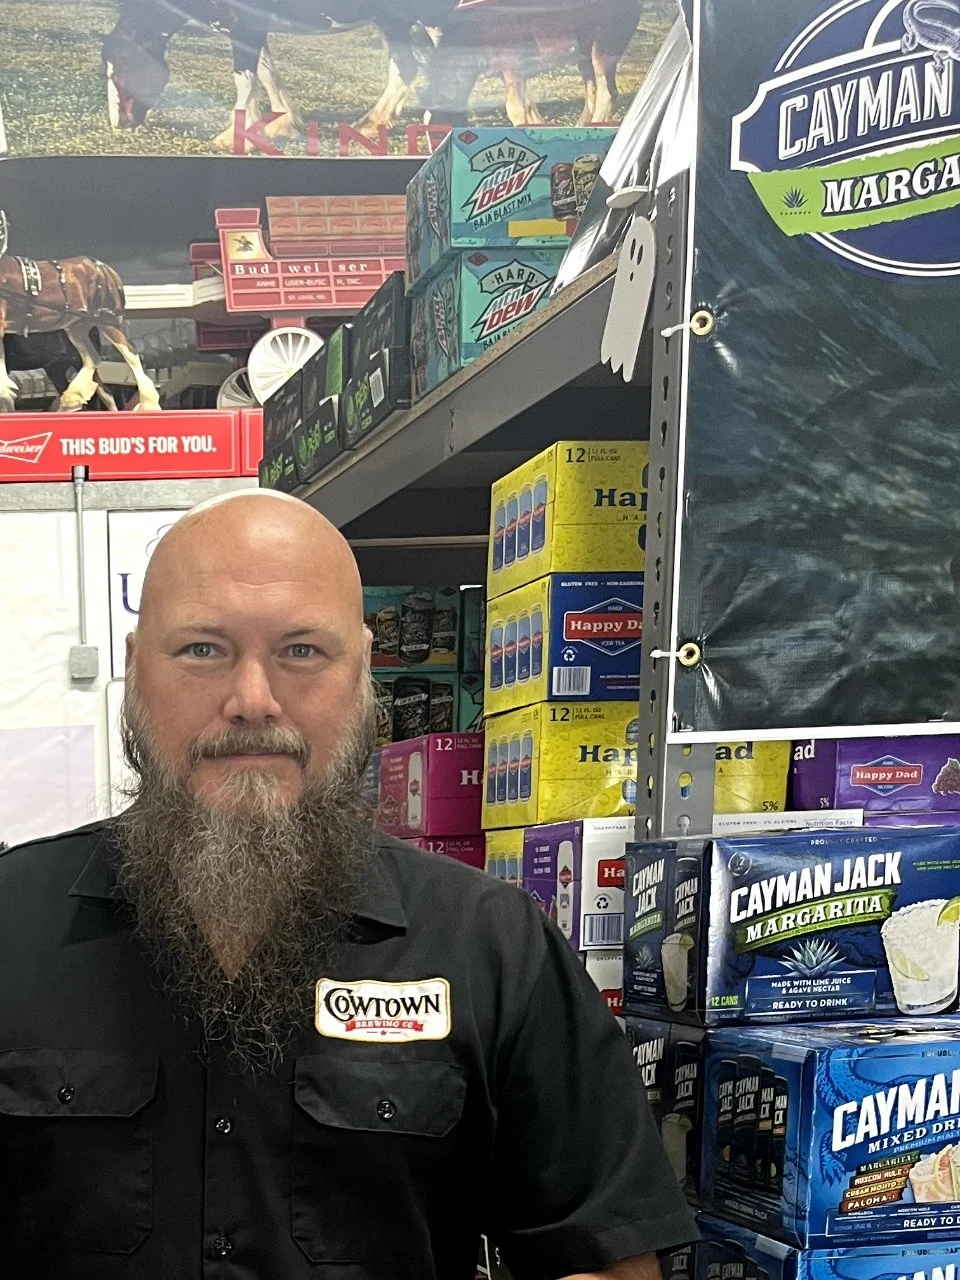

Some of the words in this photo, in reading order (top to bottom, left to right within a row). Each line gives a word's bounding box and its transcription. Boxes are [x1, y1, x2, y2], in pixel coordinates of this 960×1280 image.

[778, 58, 953, 160] CAYMAN
[485, 147, 526, 163] HARD
[822, 153, 960, 215] MARGA
[473, 213, 492, 231] BAJA
[493, 203, 515, 222] BLAST
[517, 193, 533, 208] MIX
[60, 438, 95, 456] THIS
[98, 437, 145, 455] BUD'S
[148, 437, 177, 453] FOR
[181, 435, 217, 453] YOU.
[565, 448, 585, 463] 12
[550, 708, 570, 722] 12
[435, 739, 452, 750] 12
[855, 770, 892, 780] Happy
[896, 770, 918, 779] Dad
[763, 801, 778, 811] 5%
[633, 859, 664, 897] CAYMAN
[730, 862, 832, 923] CAYMAN
[835, 852, 902, 893] JACK
[636, 886, 657, 918] JACK
[746, 895, 883, 943] MARGARITA
[772, 980, 790, 988] MADE
[792, 979, 810, 987] WITH
[831, 977, 851, 985] JUICE
[788, 986, 811, 994] AGAVE
[813, 985, 840, 993] NECTAR
[323, 988, 441, 1022] COWTOWN
[711, 998, 719, 1006] 12
[720, 996, 738, 1006] CANS
[772, 1000, 803, 1010] READY
[806, 1000, 817, 1008] TO
[820, 998, 847, 1007] DRINK
[356, 1020, 399, 1029] BREWING
[848, 1195, 887, 1209] PALOMA
[904, 1218, 936, 1228] READY
[941, 1217, 953, 1226] TO
